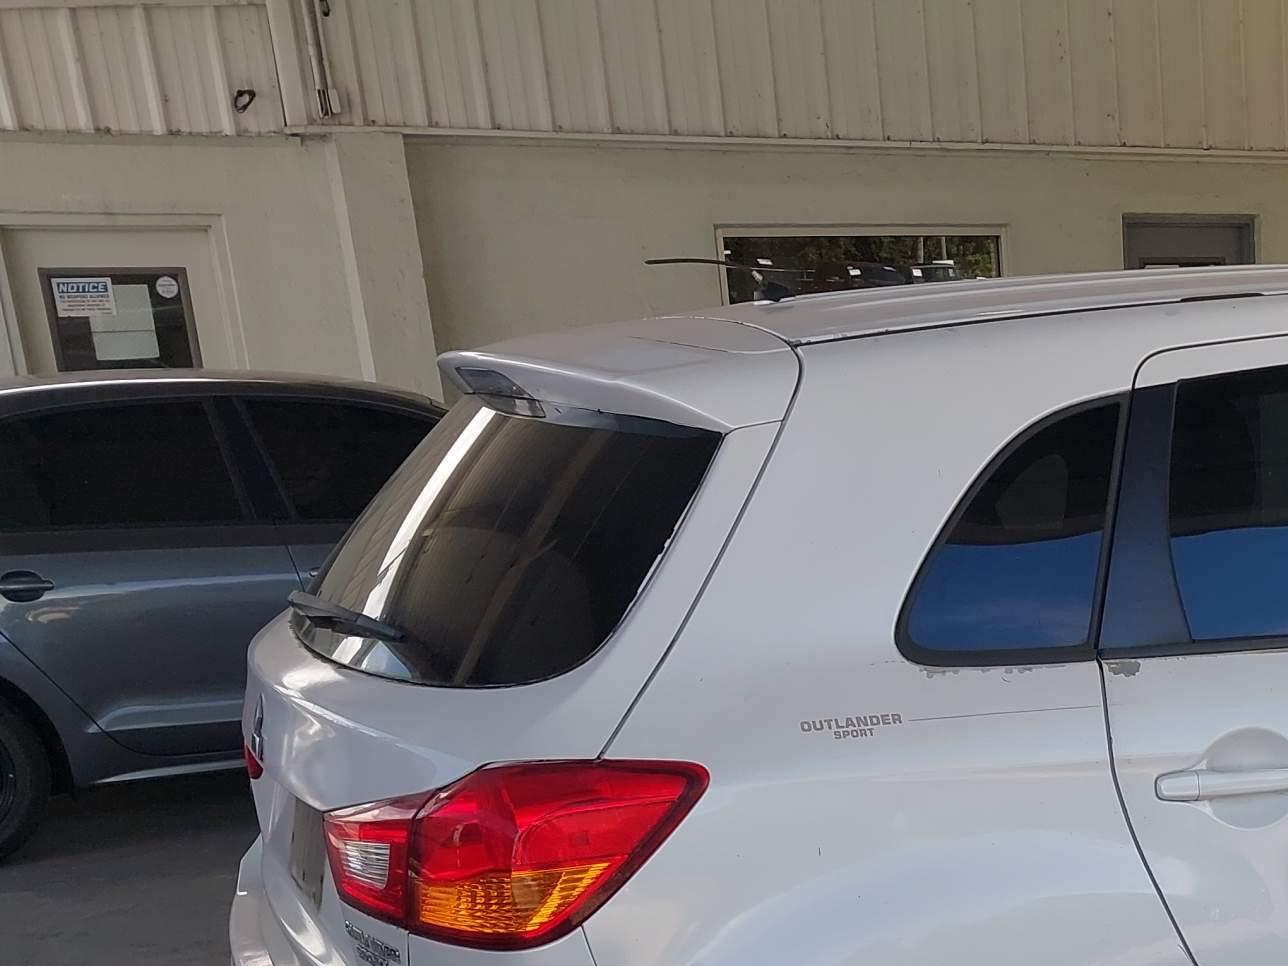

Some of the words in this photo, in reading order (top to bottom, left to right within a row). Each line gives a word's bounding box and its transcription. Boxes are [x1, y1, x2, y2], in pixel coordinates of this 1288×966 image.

[59, 282, 106, 293] NOTICE
[800, 713, 903, 732] OUTLANDER
[834, 728, 875, 740] SPORT
